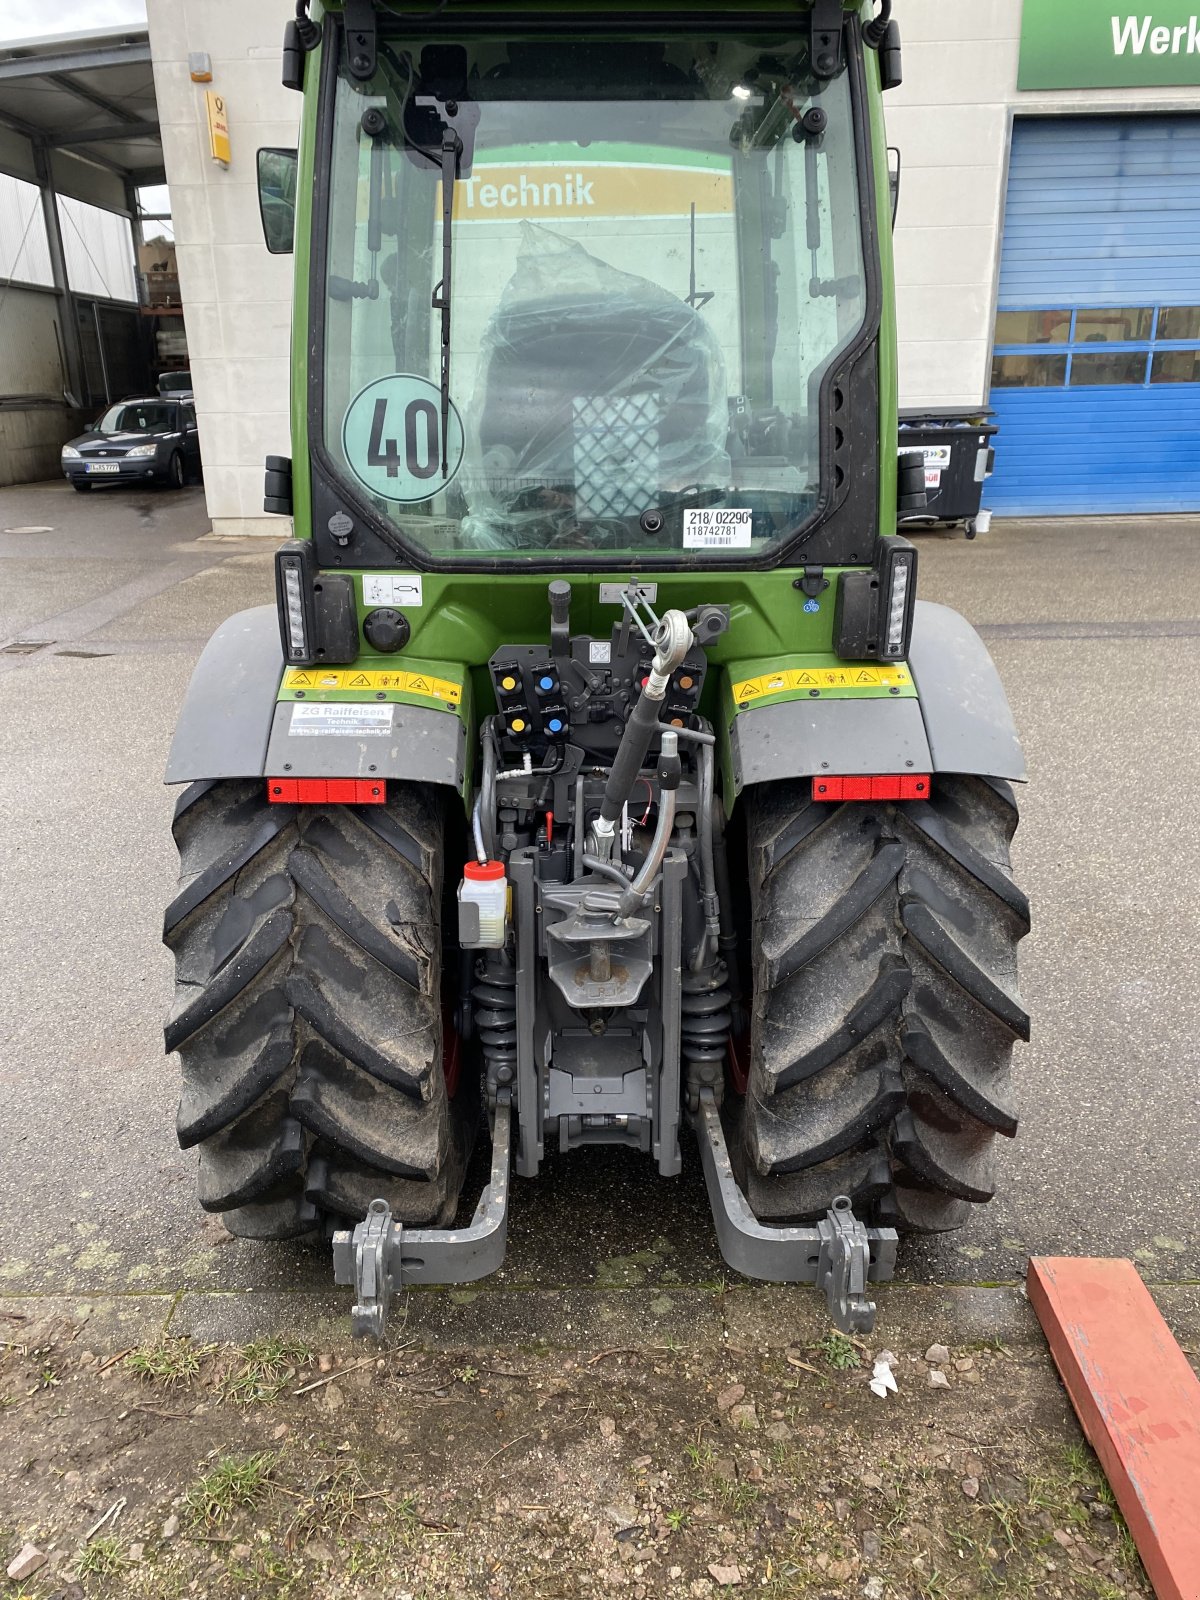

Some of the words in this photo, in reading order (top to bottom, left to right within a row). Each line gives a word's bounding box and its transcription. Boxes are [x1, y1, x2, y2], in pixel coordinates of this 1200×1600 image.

[1111, 15, 1200, 55] Werk
[465, 173, 595, 208] Technik
[367, 398, 440, 480] 40
[715, 511, 749, 525] 02290
[686, 525, 736, 536] 118742781
[301, 707, 320, 715] ZG
[323, 707, 385, 716] Raiffeisen
